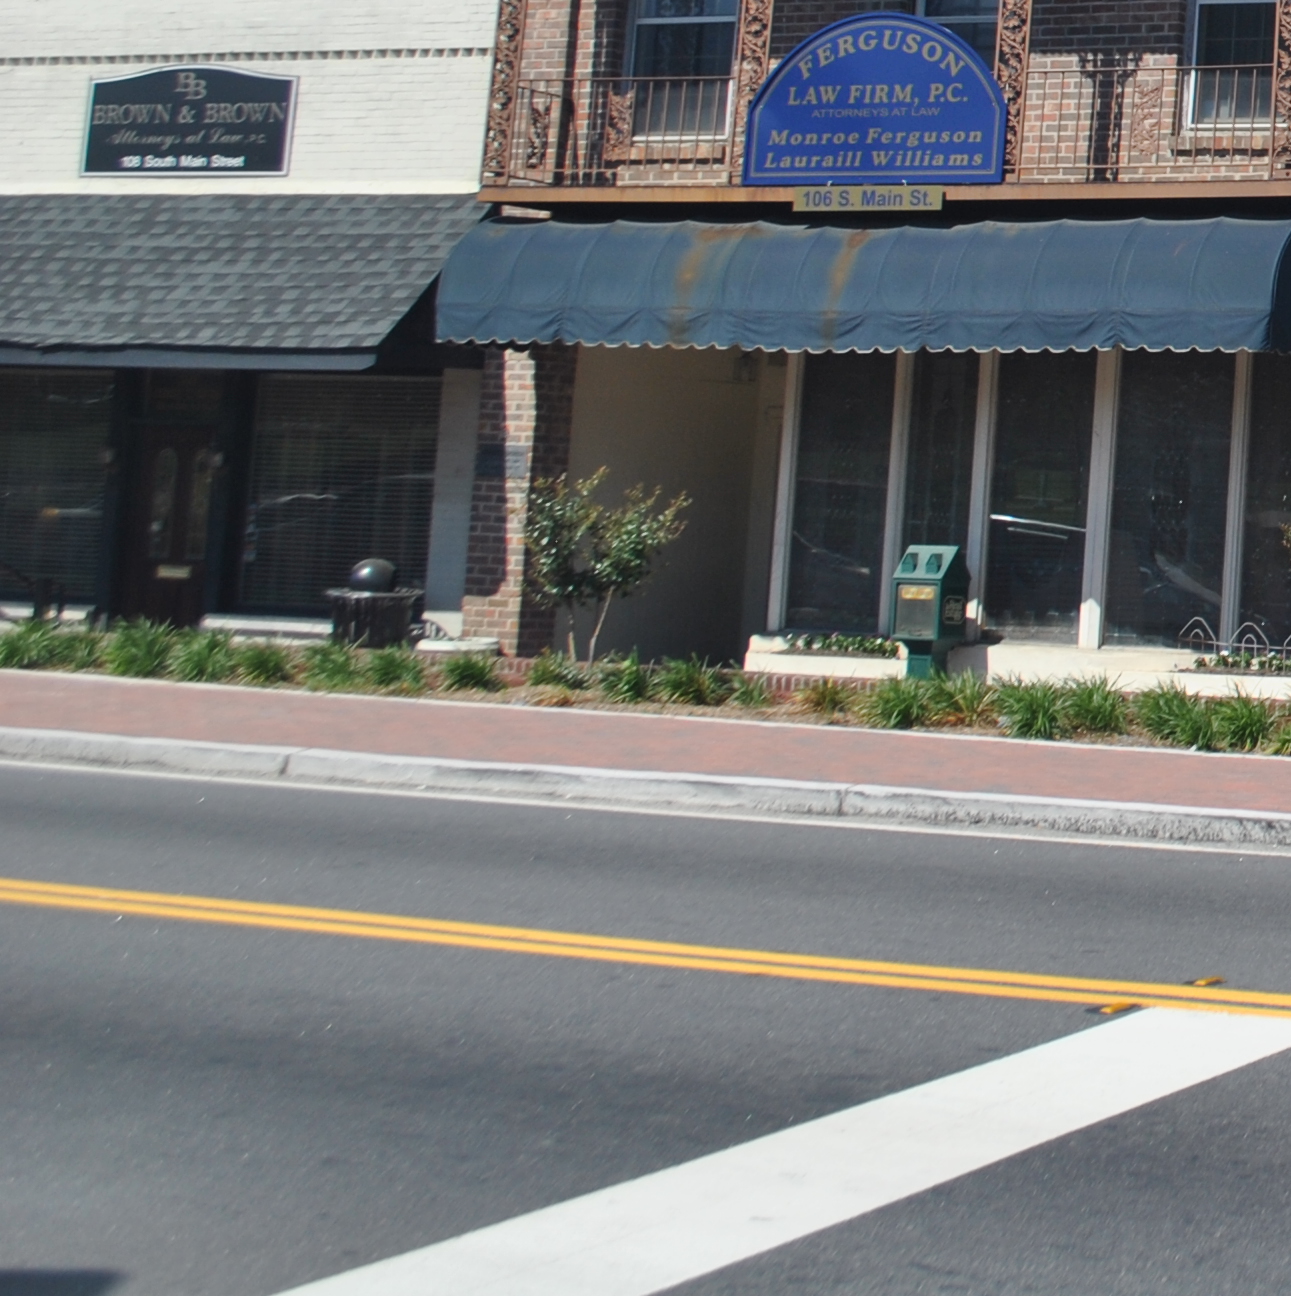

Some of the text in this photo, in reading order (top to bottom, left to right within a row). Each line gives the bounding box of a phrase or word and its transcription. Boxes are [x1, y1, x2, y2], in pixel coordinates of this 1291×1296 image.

[799, 30, 966, 80] FERGUSON
[788, 83, 968, 105] LAW FIRM, P.C.
[92, 102, 286, 125] BROWN & BROWN
[812, 106, 941, 118] ATTORNEYS AT LAW
[106, 128, 181, 150] Attorneys
[185, 127, 204, 144] at
[767, 128, 983, 147] Monroe Ferguson
[120, 155, 246, 168] 108 South Main Street
[764, 150, 983, 168] Lauraill Williams
[803, 189, 933, 207] 106 S. Main St.
